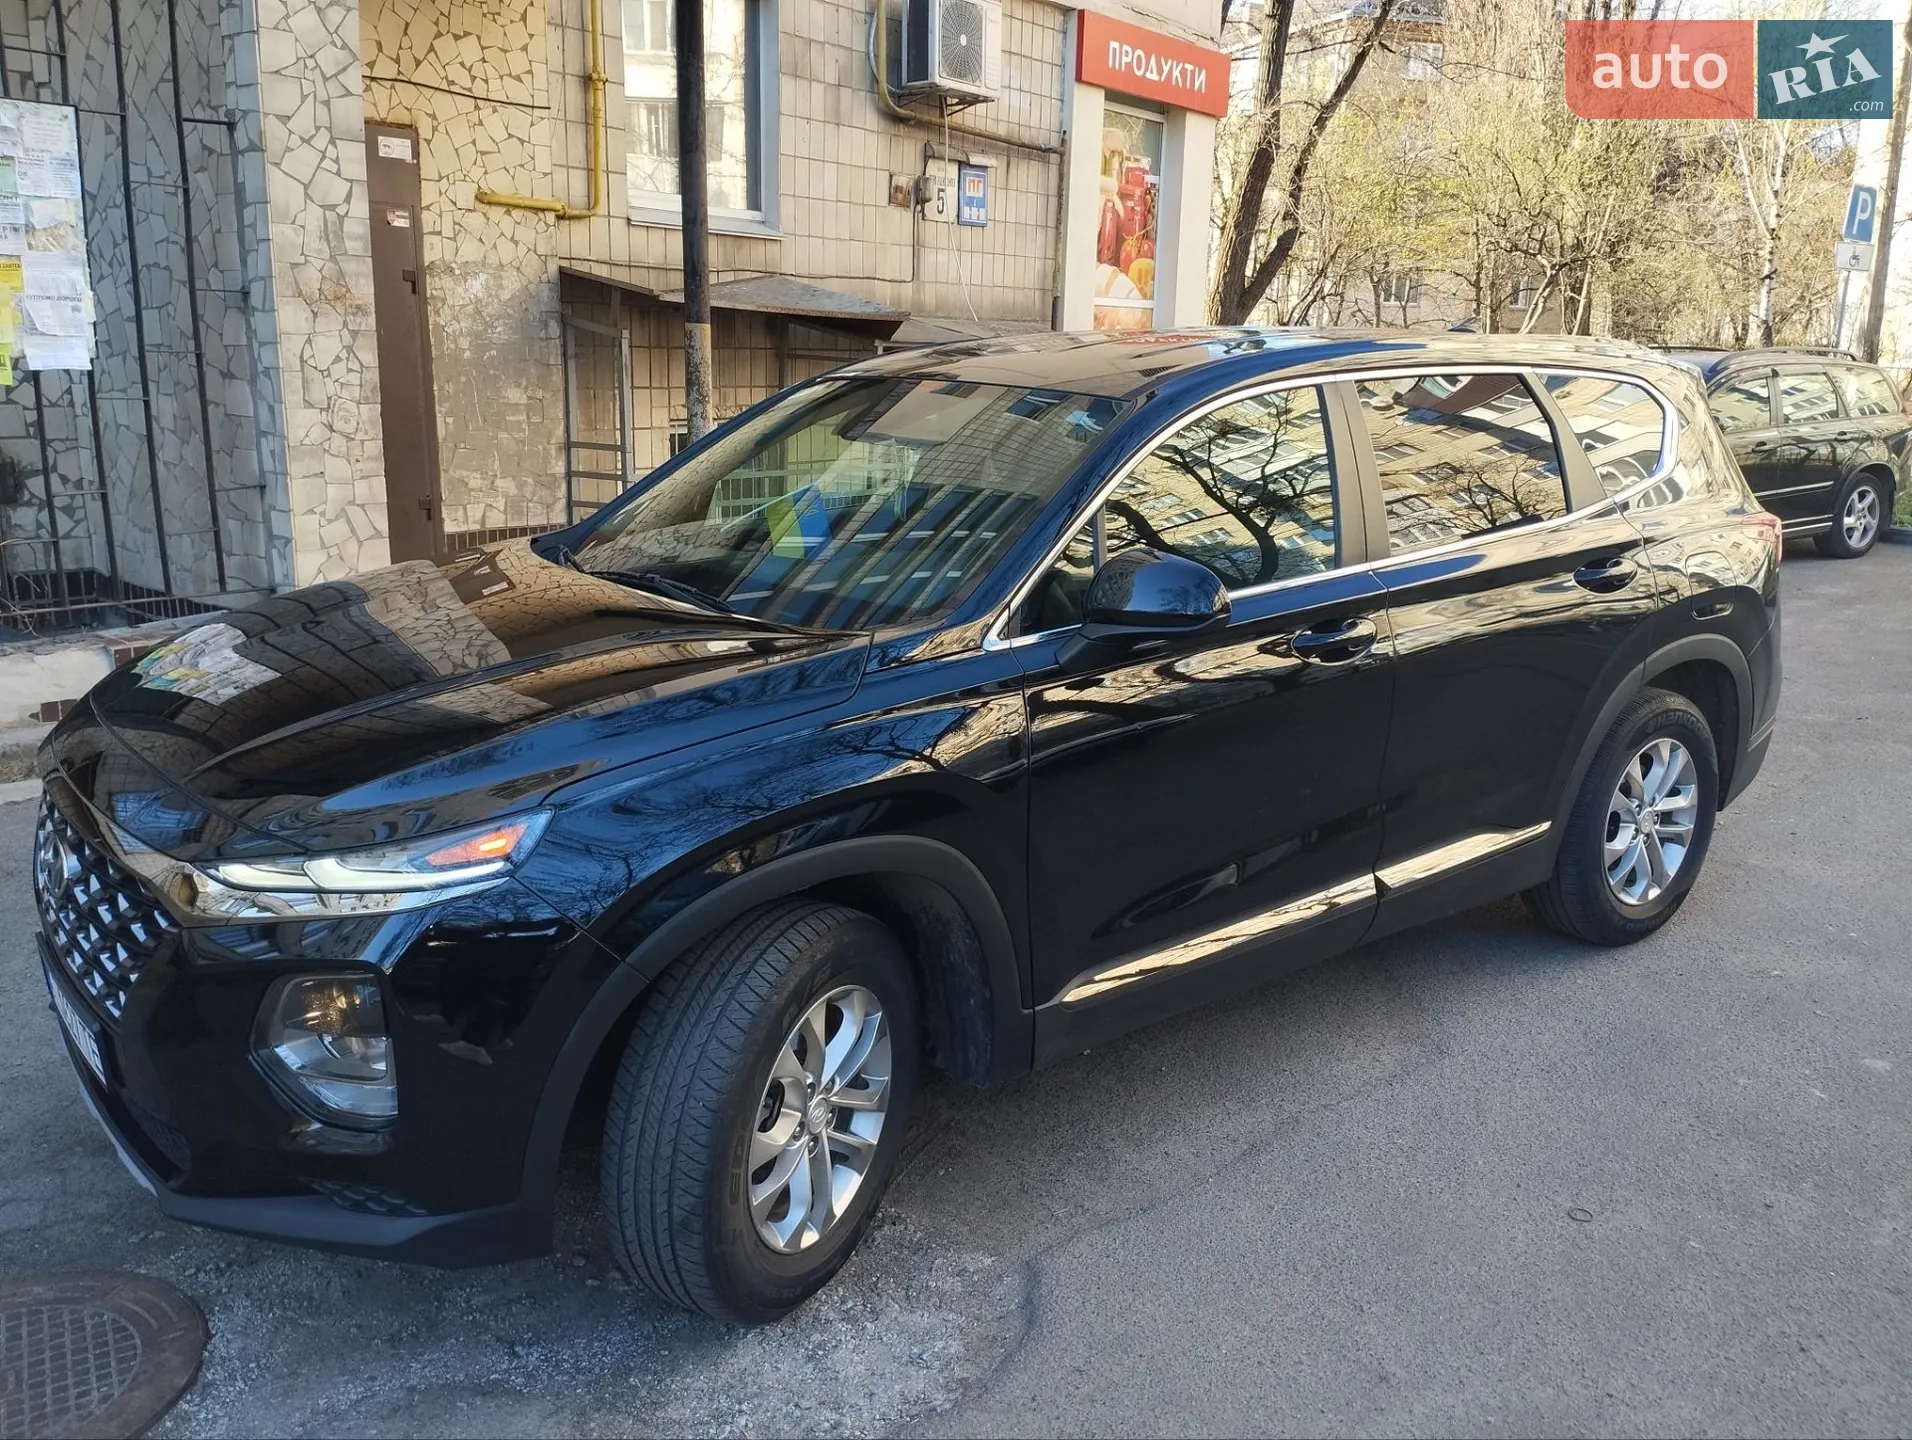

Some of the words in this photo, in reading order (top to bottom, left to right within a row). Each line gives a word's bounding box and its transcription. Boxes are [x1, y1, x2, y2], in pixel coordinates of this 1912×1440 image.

[1109, 40, 1206, 94] ПРОДУКТИ
[937, 187, 946, 215] 5
[1853, 191, 1872, 234] P
